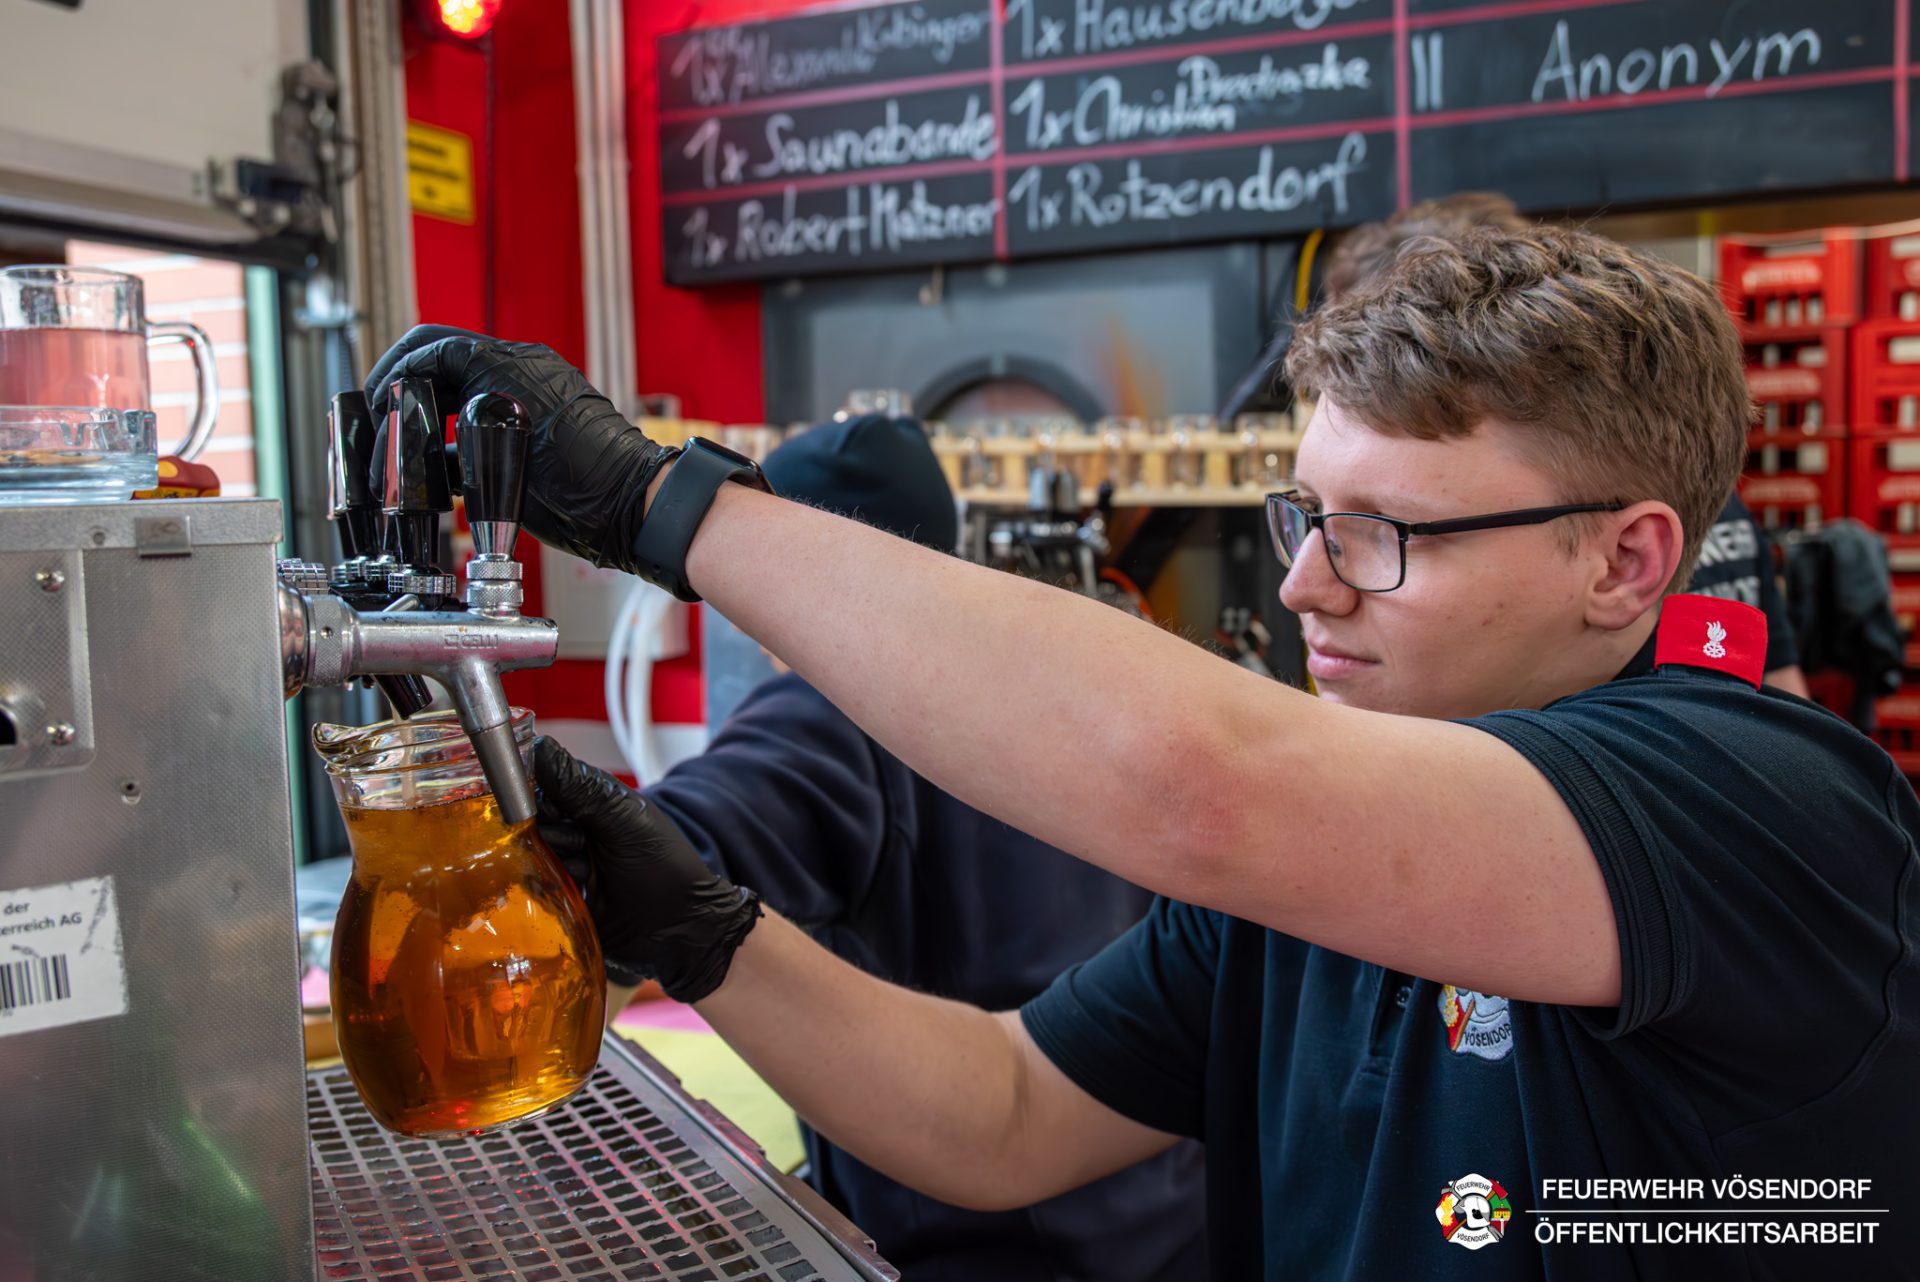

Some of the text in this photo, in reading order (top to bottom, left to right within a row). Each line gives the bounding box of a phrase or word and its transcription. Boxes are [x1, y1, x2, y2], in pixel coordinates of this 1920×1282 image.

[1005, 0, 1372, 58] 1x Hausenberg
[1531, 19, 1821, 103] Anonym
[683, 95, 1000, 189] 1x Saunabande
[1010, 78, 1073, 149] 1x
[1009, 132, 1369, 232] 1x Rotzendorf
[682, 206, 727, 267] 1x
[734, 184, 868, 261] Robert
[4, 902, 30, 916] der
[60, 911, 82, 927] AG
[1464, 1023, 1512, 1048] VÖSENDOR
